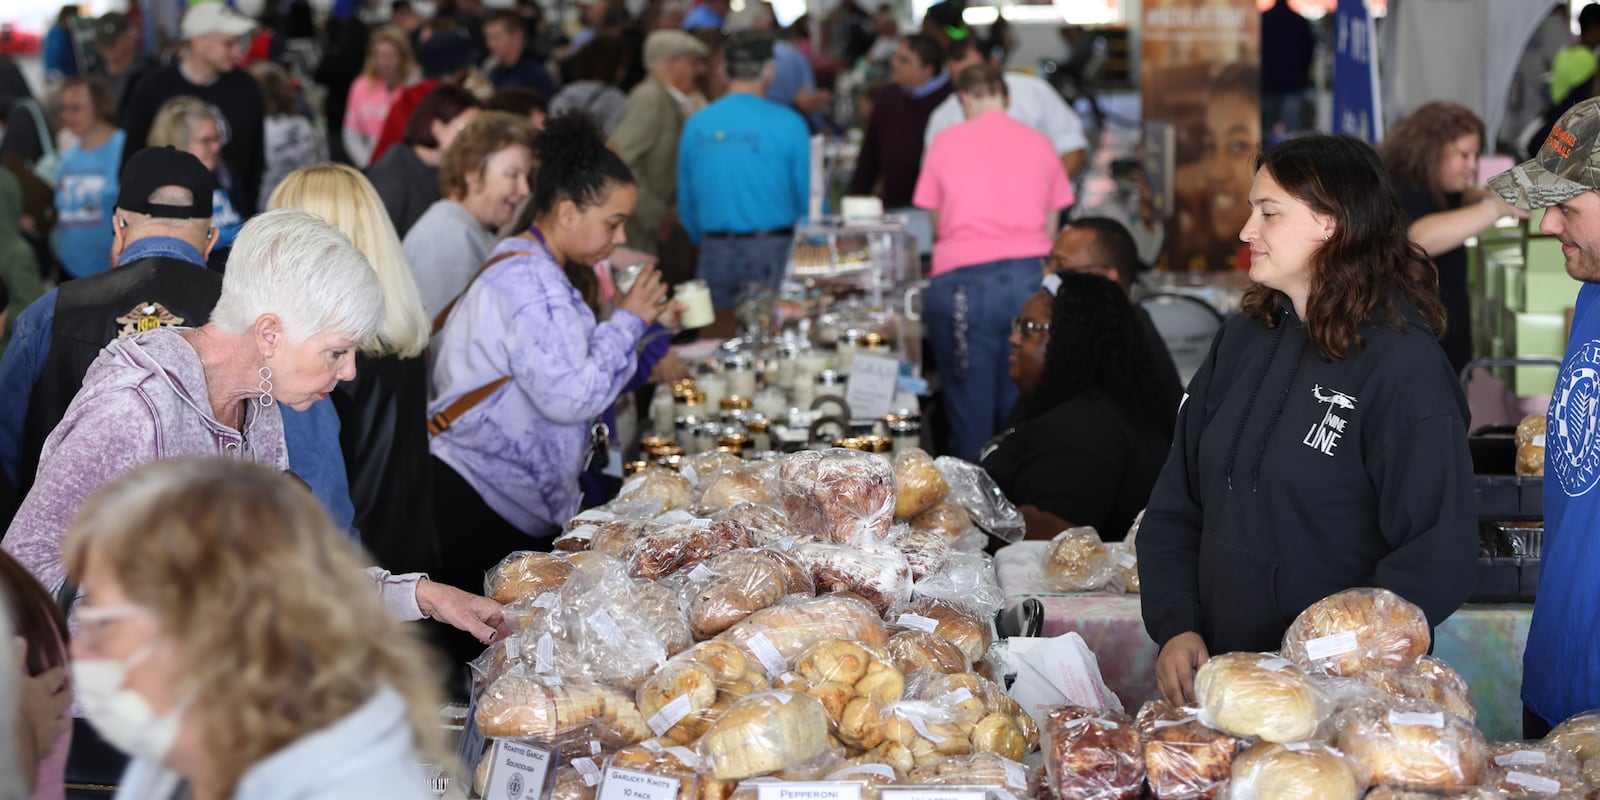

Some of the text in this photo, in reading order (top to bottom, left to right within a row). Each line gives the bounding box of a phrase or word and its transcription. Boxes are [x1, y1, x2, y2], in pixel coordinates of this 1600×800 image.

[1325, 413, 1348, 433] NINE
[1303, 423, 1342, 457] LINE
[503, 742, 545, 761] ROASTED GARLIC
[505, 758, 535, 773] SOURDOUGH
[612, 770, 645, 785] GARLICKY
[646, 777, 671, 789] KNOTS
[623, 787, 651, 800] 10 PACK
[780, 789, 839, 799] PEPPERONI
